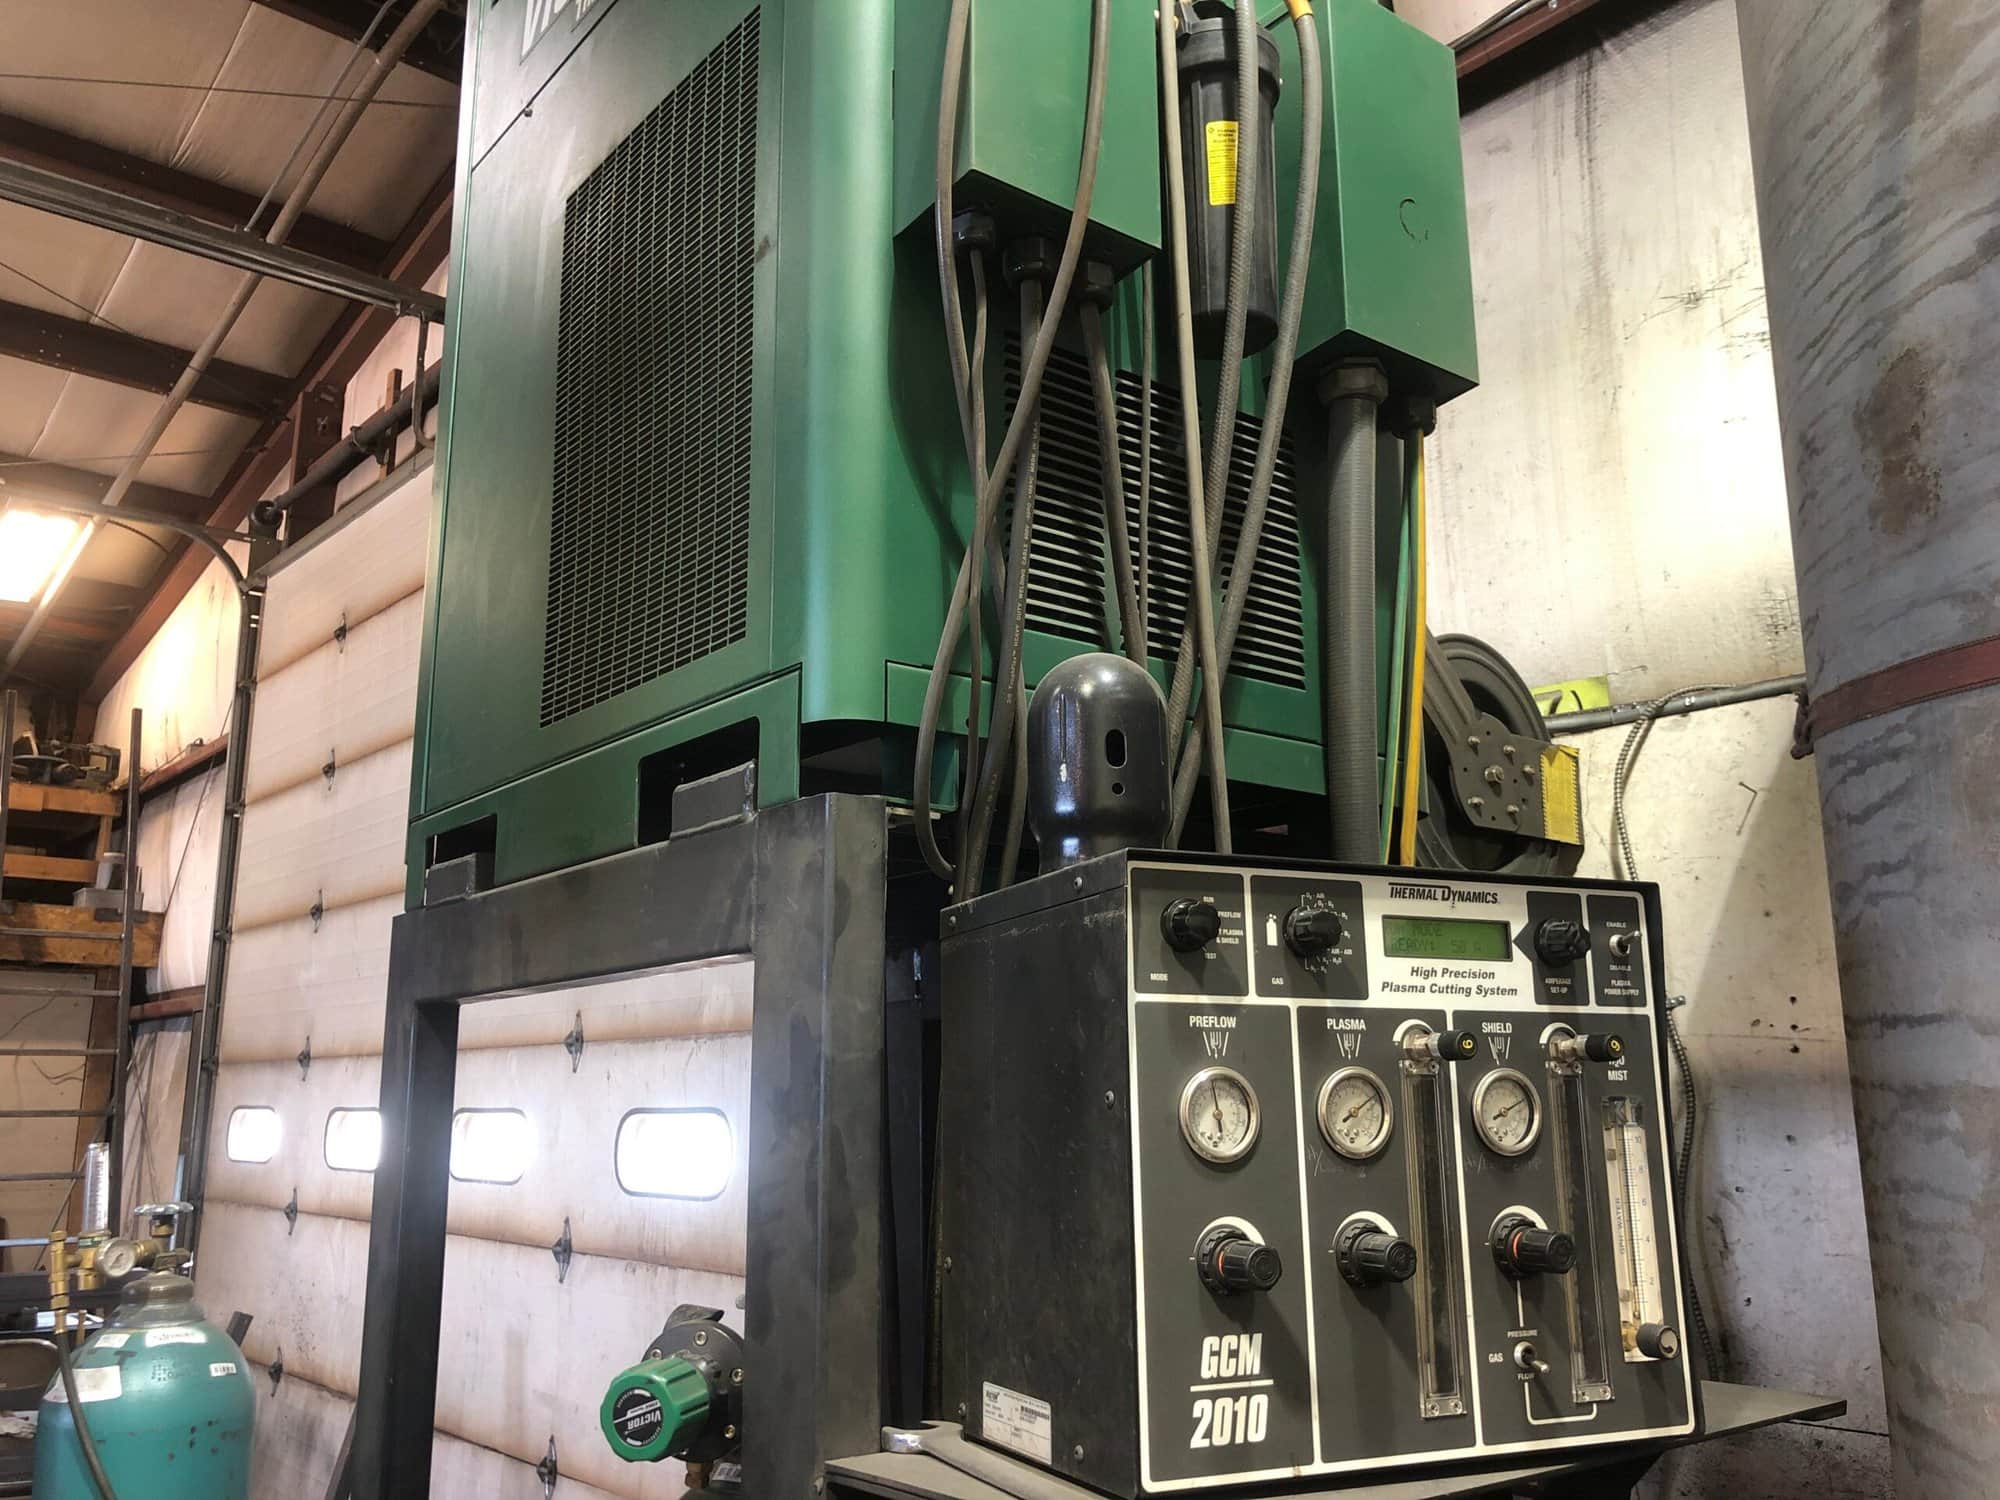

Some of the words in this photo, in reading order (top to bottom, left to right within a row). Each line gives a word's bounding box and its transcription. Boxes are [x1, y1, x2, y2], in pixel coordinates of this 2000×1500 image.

[1389, 885, 1438, 901] THERMAL
[1441, 885, 1498, 904] DYNAMICS
[1410, 966, 1437, 980] High
[1441, 967, 1496, 980] Precision
[1381, 981, 1426, 993] Plasma
[1430, 982, 1472, 997] Cutting
[1475, 984, 1518, 997] System
[1189, 1015, 1236, 1029] PREFLOW
[1327, 1018, 1366, 1031] PLASMA
[1482, 1022, 1512, 1034] SHIELD
[1608, 1070, 1628, 1081] MIST
[1200, 1333, 1262, 1379] GCM
[1488, 1352, 1503, 1363] GAS
[627, 1410, 661, 1430] VICTOR
[1190, 1394, 1269, 1449] 2010
